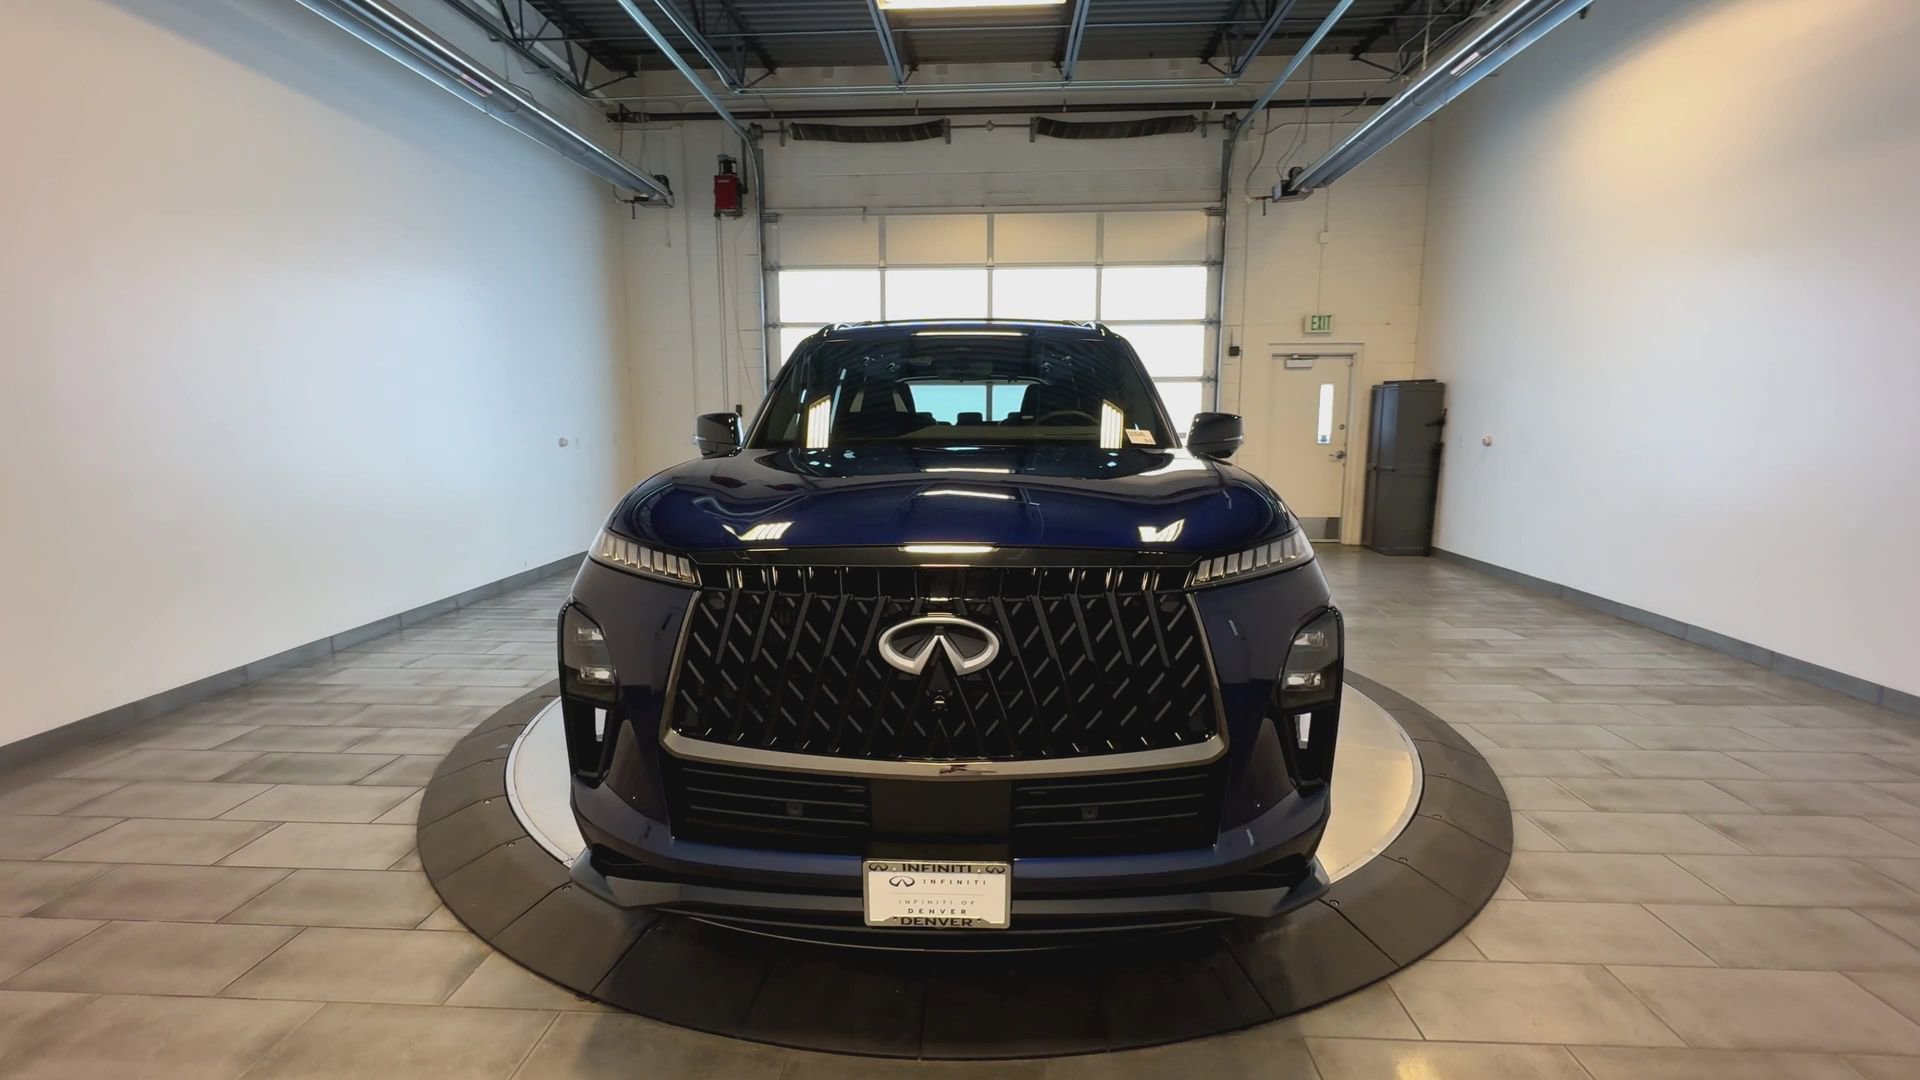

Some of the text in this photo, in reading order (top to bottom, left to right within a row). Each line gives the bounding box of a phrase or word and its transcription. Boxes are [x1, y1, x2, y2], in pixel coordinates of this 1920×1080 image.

[1311, 315, 1332, 330] EXIT
[902, 863, 972, 873] INFINITI
[900, 917, 973, 927] DENVER
